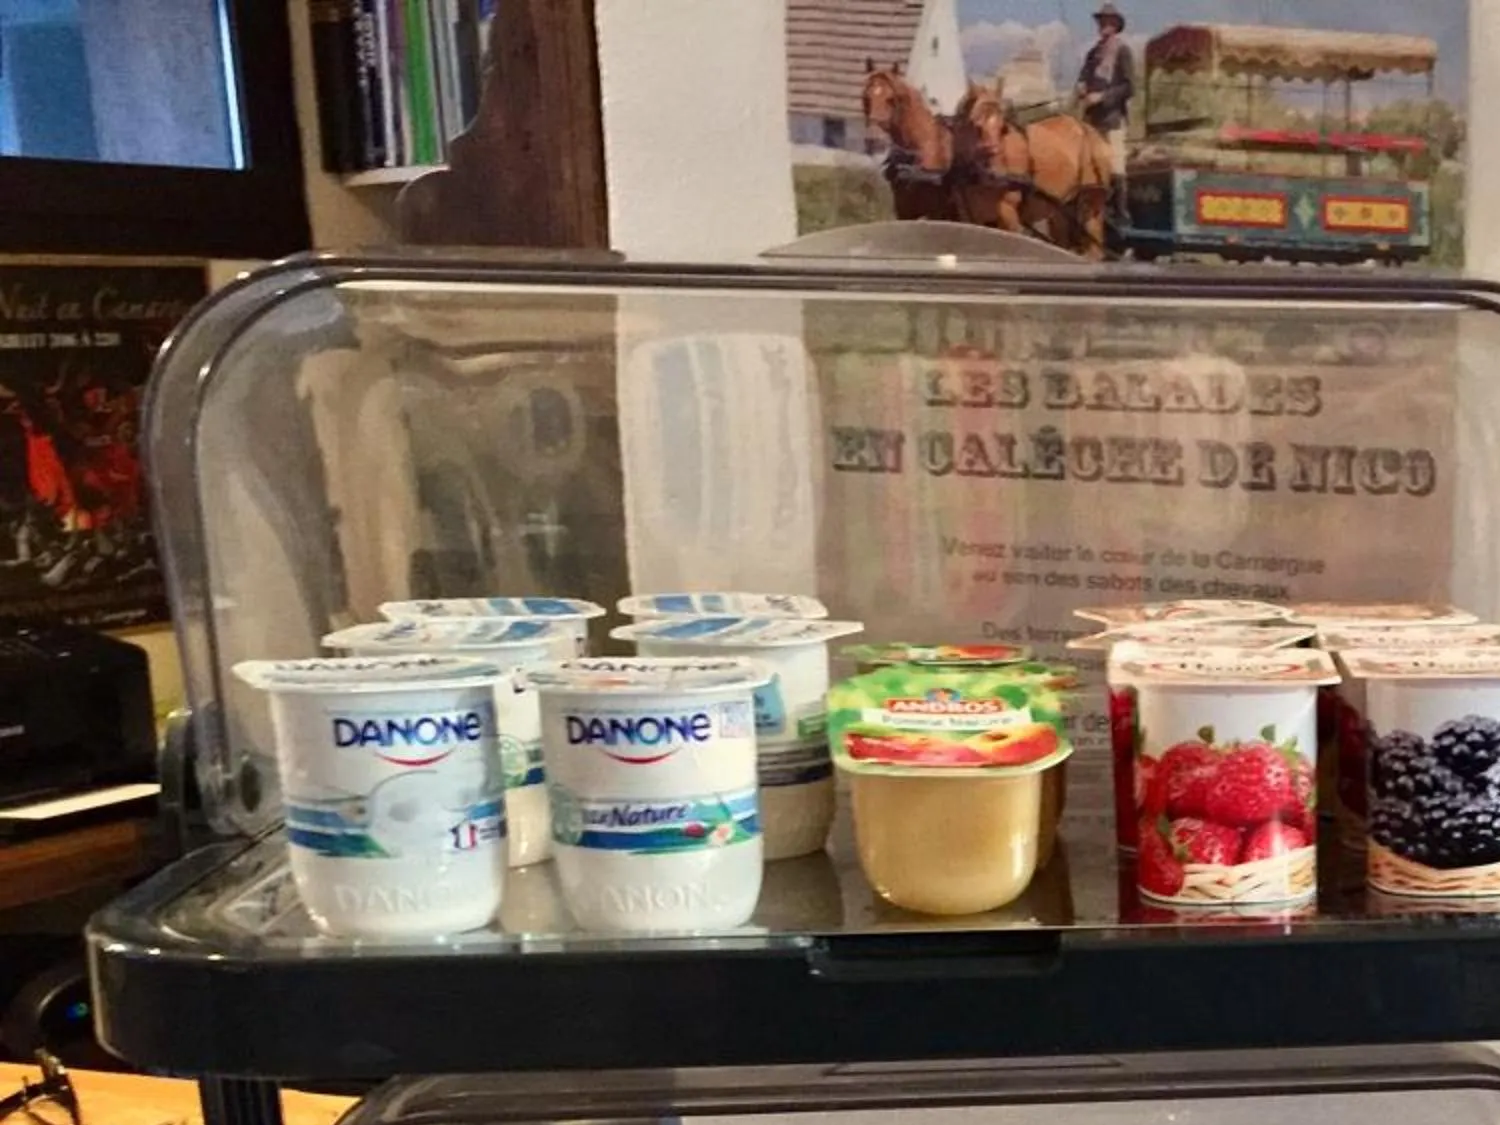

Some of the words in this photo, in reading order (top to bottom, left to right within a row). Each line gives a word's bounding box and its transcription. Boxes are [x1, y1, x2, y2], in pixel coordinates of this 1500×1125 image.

[925, 369, 1030, 410] LES
[1042, 371, 1322, 417] BALADES
[831, 426, 903, 474] EN
[1200, 439, 1277, 492] DE
[1290, 443, 1437, 496] NICO
[1215, 551, 1328, 577] Camargue
[1087, 573, 1154, 593] sabots
[892, 699, 999, 714] ANDROS
[334, 711, 482, 748] DANONE
[566, 711, 713, 746] DANONE
